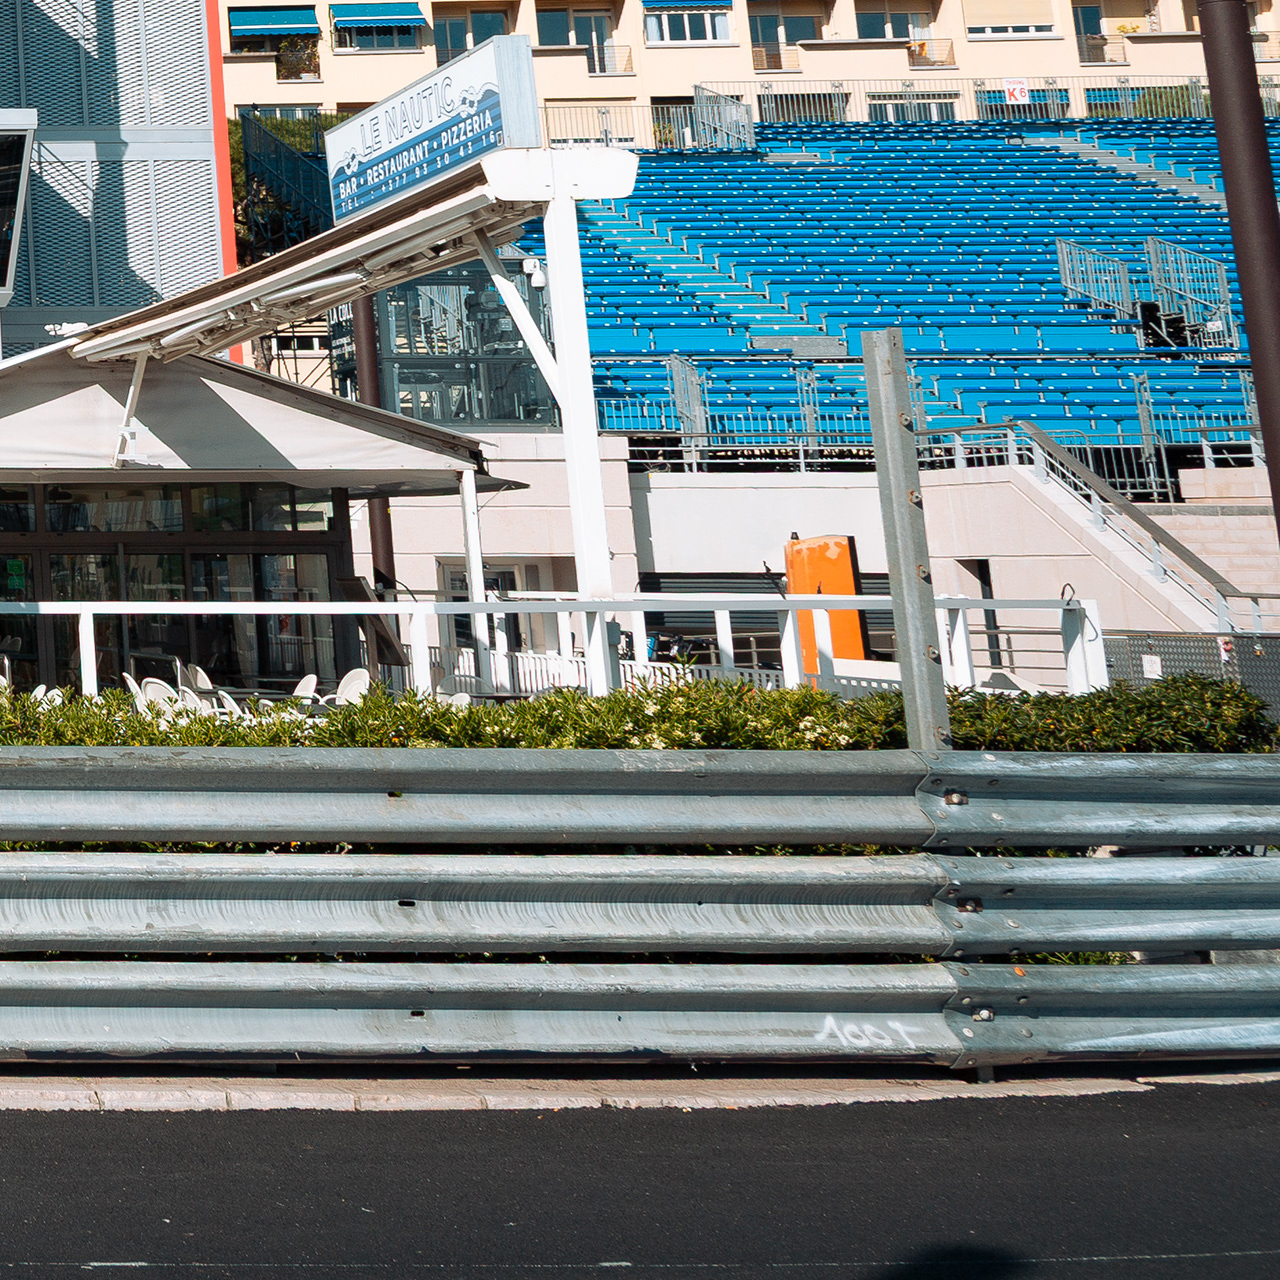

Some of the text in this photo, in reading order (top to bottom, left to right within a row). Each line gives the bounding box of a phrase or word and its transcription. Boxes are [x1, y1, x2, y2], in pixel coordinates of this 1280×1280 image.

[338, 109, 493, 200] BAR RESTAURANT PIZZERIA
[360, 76, 455, 156] LE NAUTIC
[381, 174, 407, 193] +377
[415, 163, 428, 179] 93
[436, 153, 450, 169] 30
[459, 142, 473, 157] 43
[482, 131, 495, 147] 16
